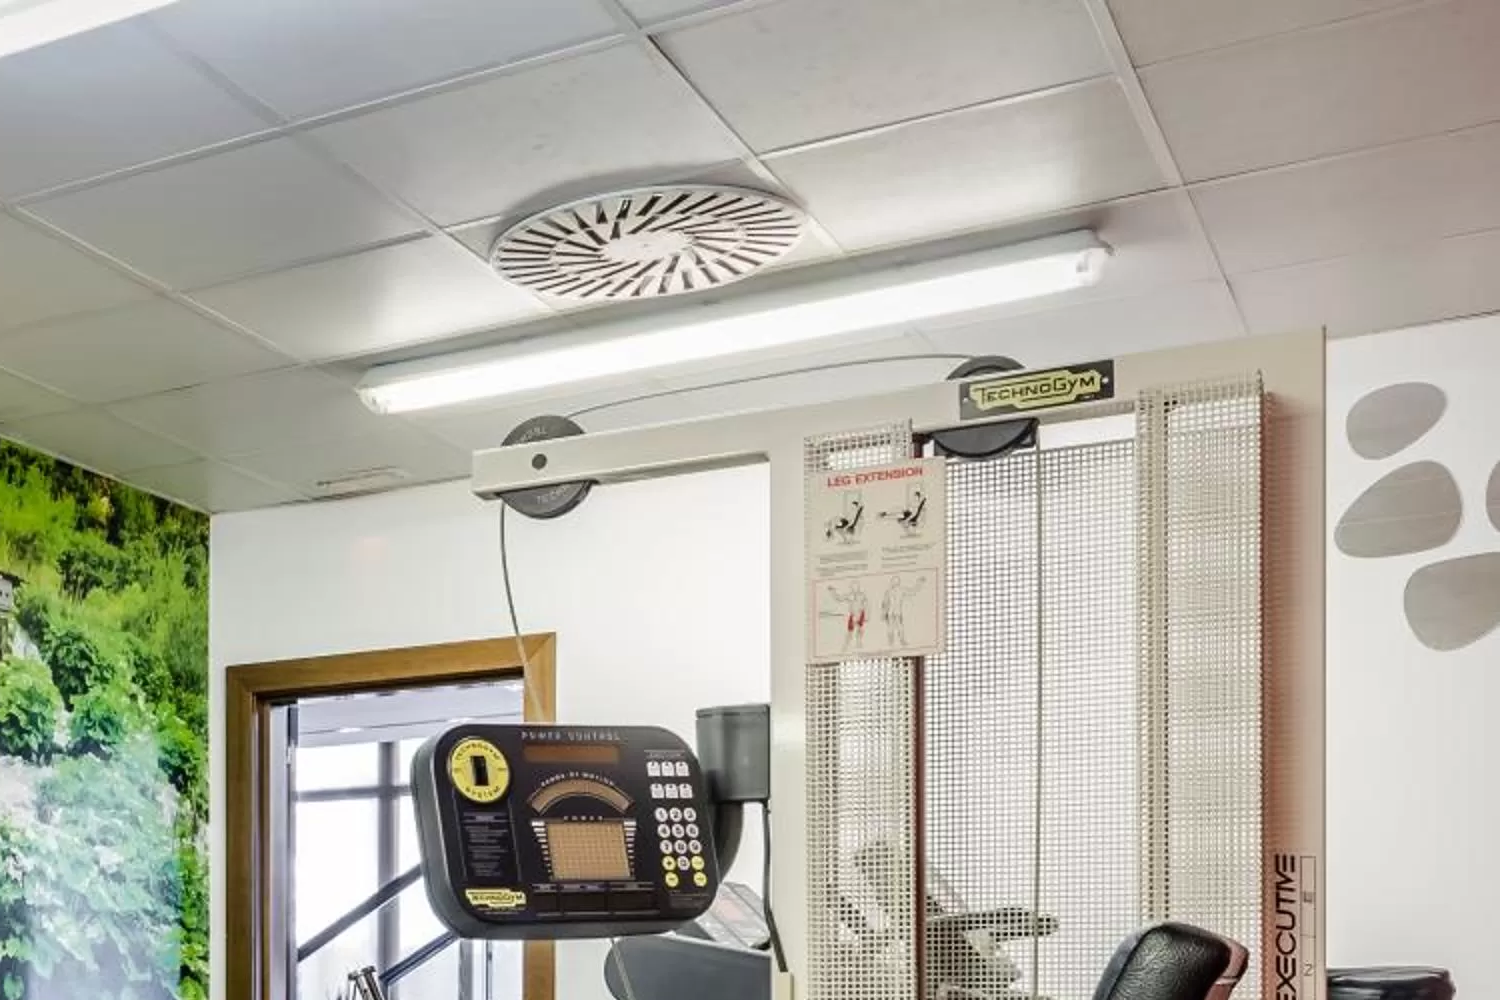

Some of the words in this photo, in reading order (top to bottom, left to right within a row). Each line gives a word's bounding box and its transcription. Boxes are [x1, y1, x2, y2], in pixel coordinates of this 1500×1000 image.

[973, 375, 1095, 406] TECHNOGYM
[827, 475, 851, 488] LEG
[855, 467, 923, 485] EXTENSION
